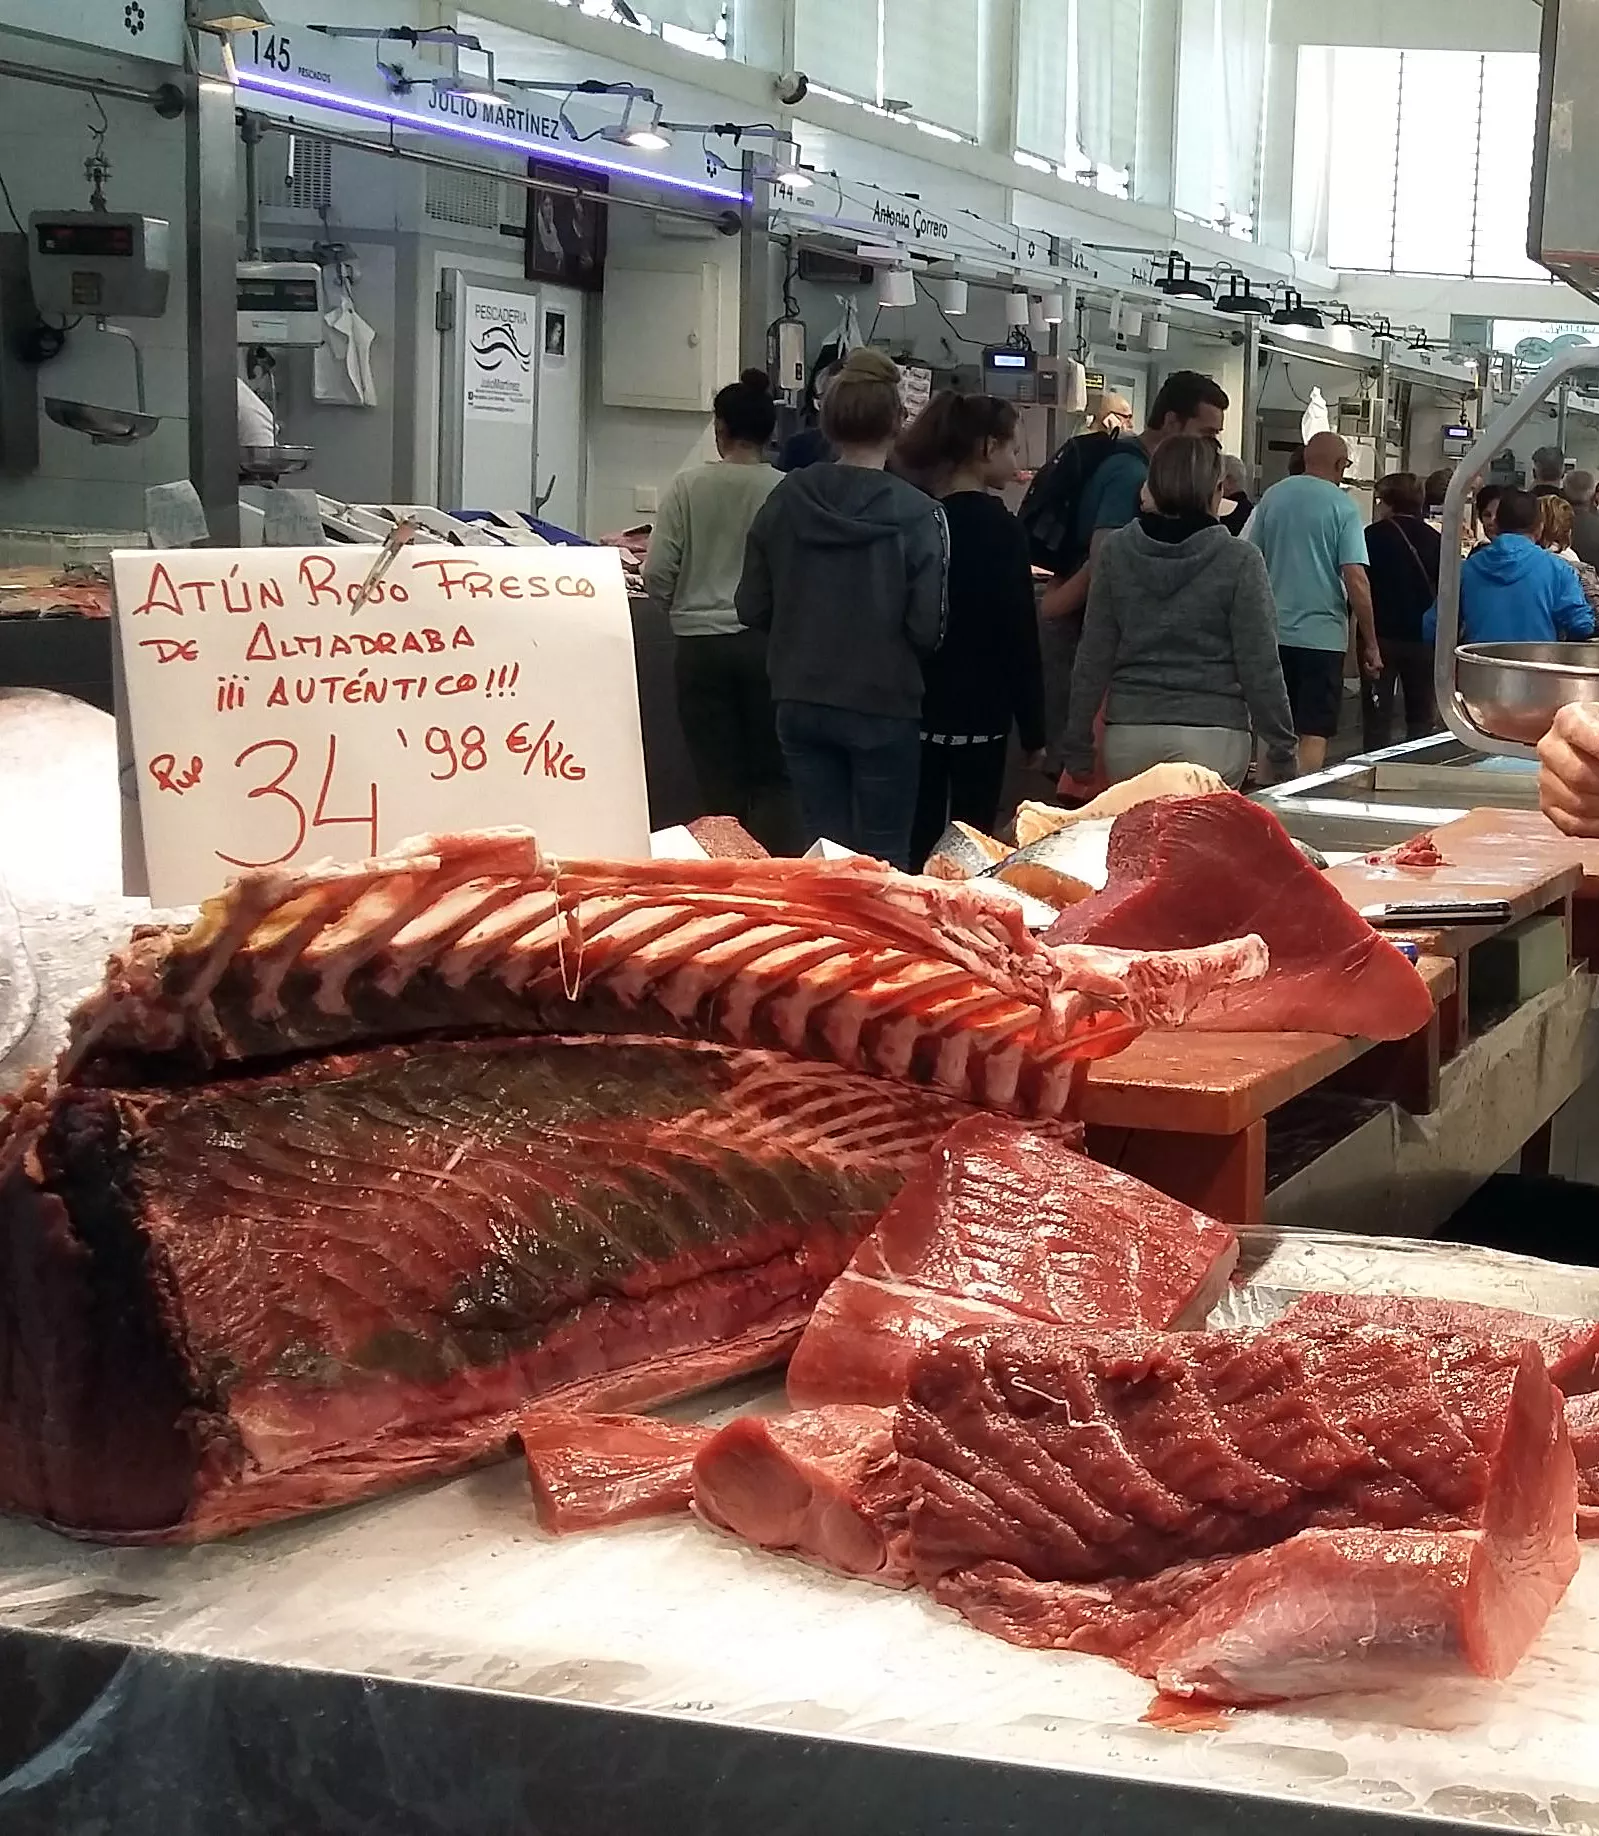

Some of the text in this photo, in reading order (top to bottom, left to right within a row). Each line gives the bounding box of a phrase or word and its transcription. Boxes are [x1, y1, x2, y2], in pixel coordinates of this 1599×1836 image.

[251, 29, 331, 84] 145 PESCADOS
[428, 91, 560, 140] JULIO MARTÍNEZ
[773, 182, 793, 202] 144
[475, 303, 528, 325] PESCADERIA
[132, 562, 284, 617] ATÚN
[411, 558, 598, 601] FRESCO
[138, 621, 475, 664] DE ALMADRABA
